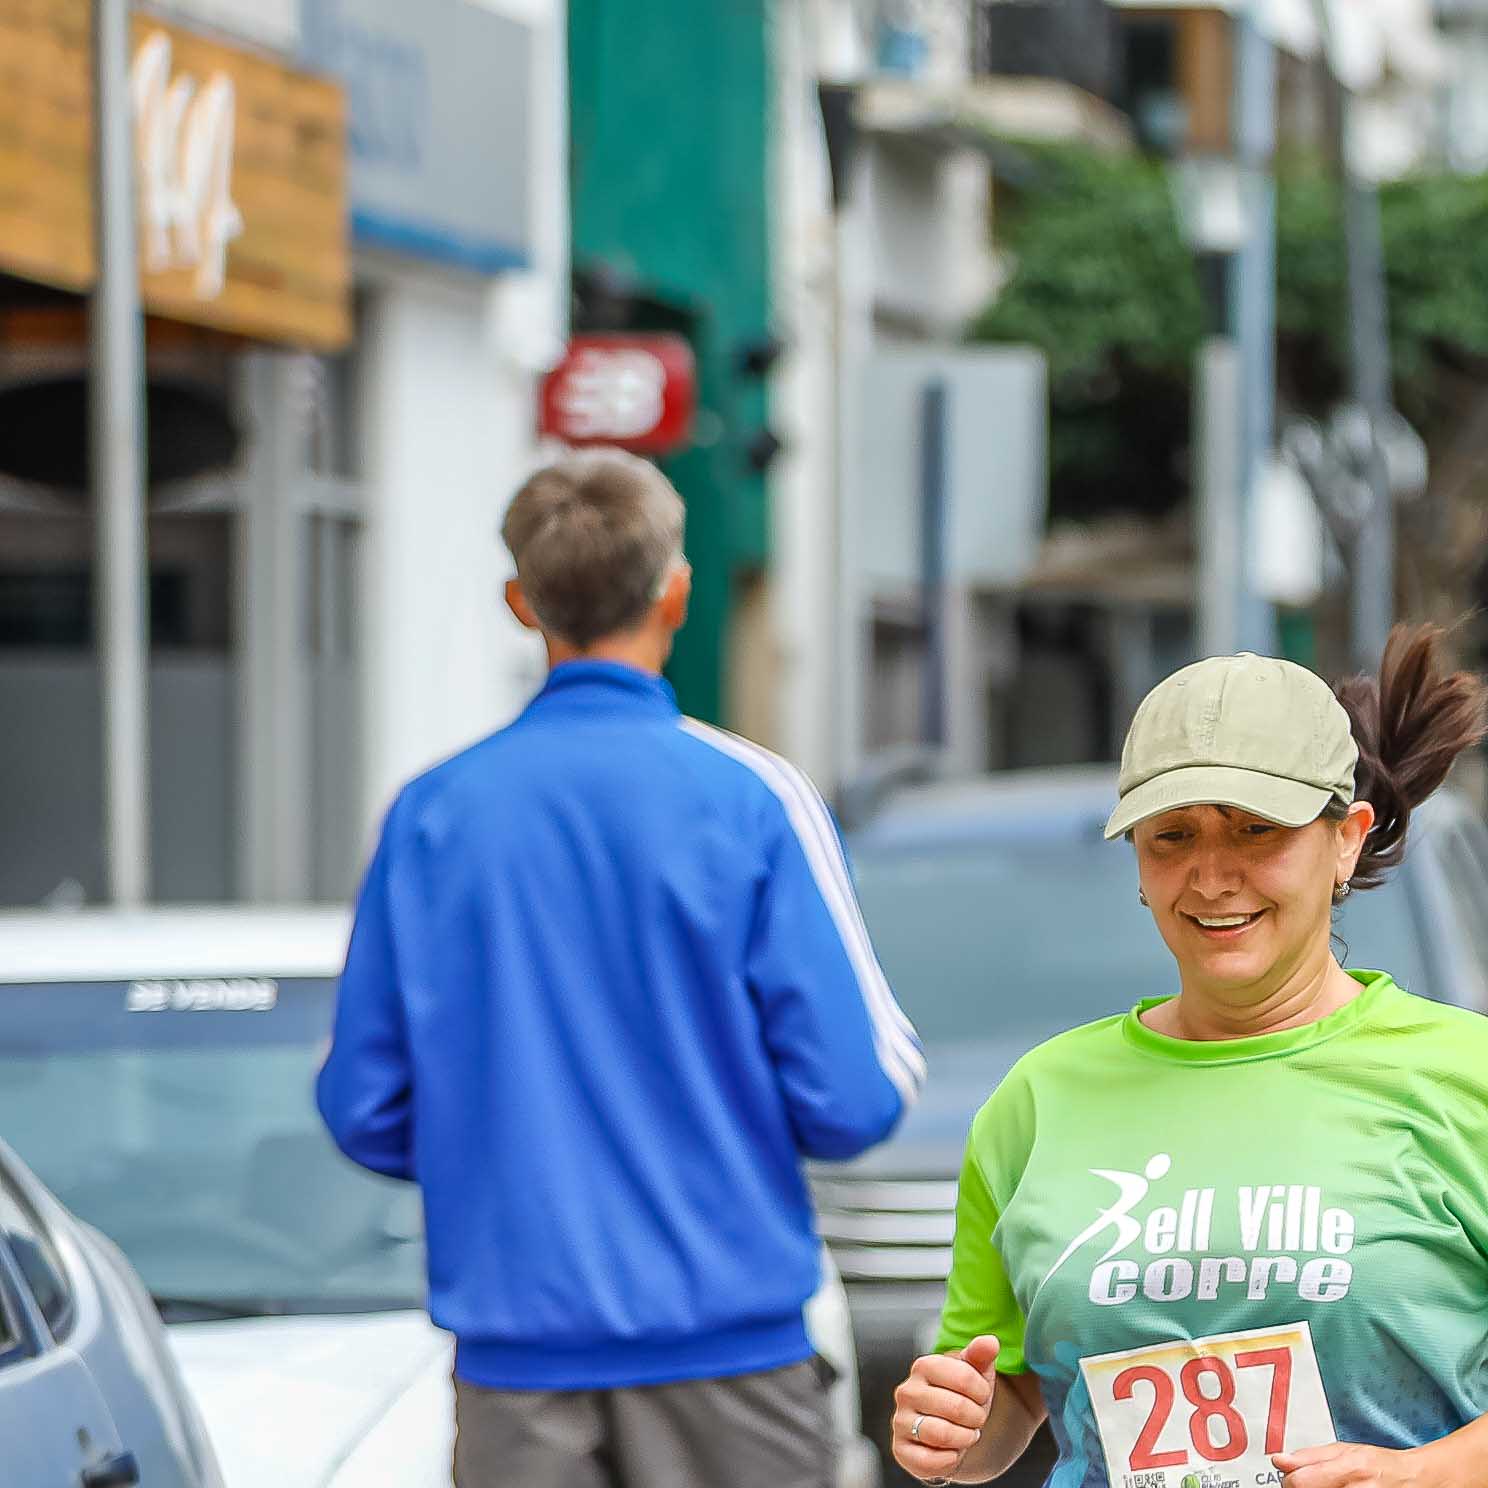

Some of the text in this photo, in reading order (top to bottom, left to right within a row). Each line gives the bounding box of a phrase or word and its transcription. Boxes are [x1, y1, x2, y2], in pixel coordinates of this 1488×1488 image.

[1238, 1184, 1356, 1255] Ville
[1088, 1255, 1354, 1306] corre
[1112, 1347, 1292, 1471] 287
